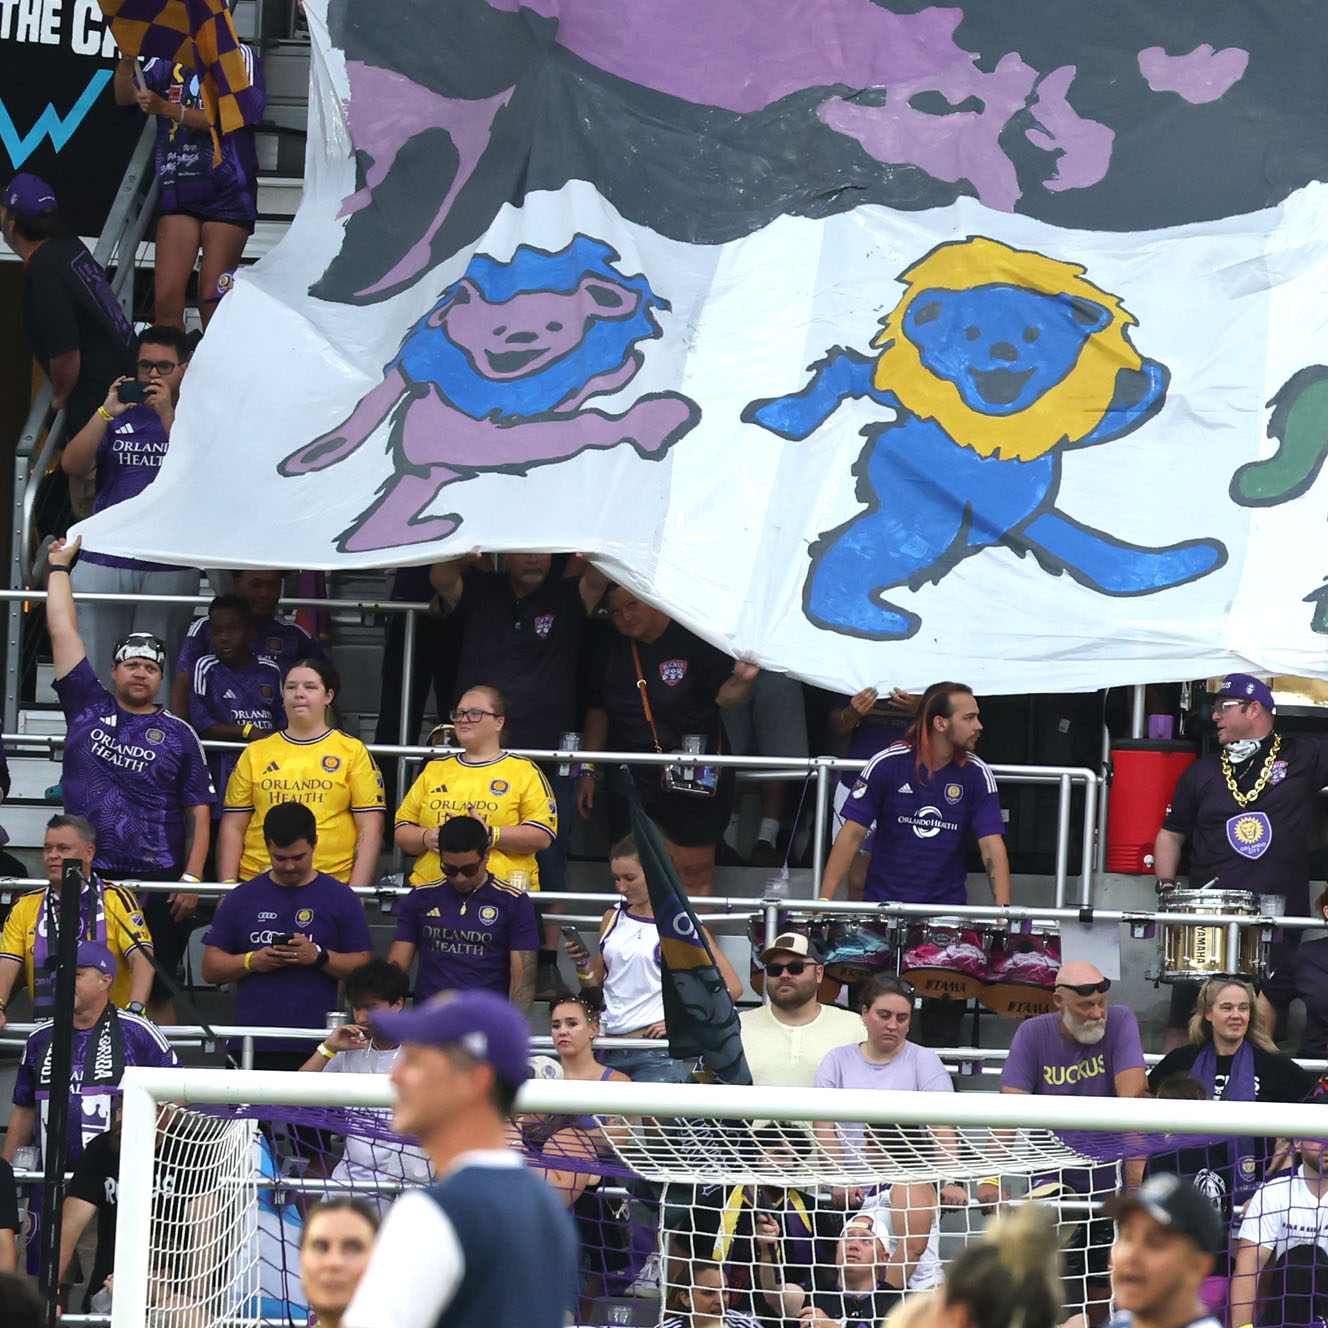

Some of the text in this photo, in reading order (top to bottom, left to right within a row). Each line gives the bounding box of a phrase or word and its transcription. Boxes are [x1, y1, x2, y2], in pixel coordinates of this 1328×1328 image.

[112, 439, 169, 453] ORLAN
[119, 452, 164, 467] HEALT
[90, 729, 156, 762] ORLANDO
[90, 743, 146, 773] HEALTH
[261, 778, 333, 792] ORLANDO
[269, 791, 324, 805] HEALTH
[430, 799, 498, 812] ORLANDO
[422, 924, 493, 944] ORLANDO
[431, 940, 485, 957] HEALTH
[1195, 924, 1207, 965] YAMAHA
[1043, 1054, 1106, 1087] RUCKUS
